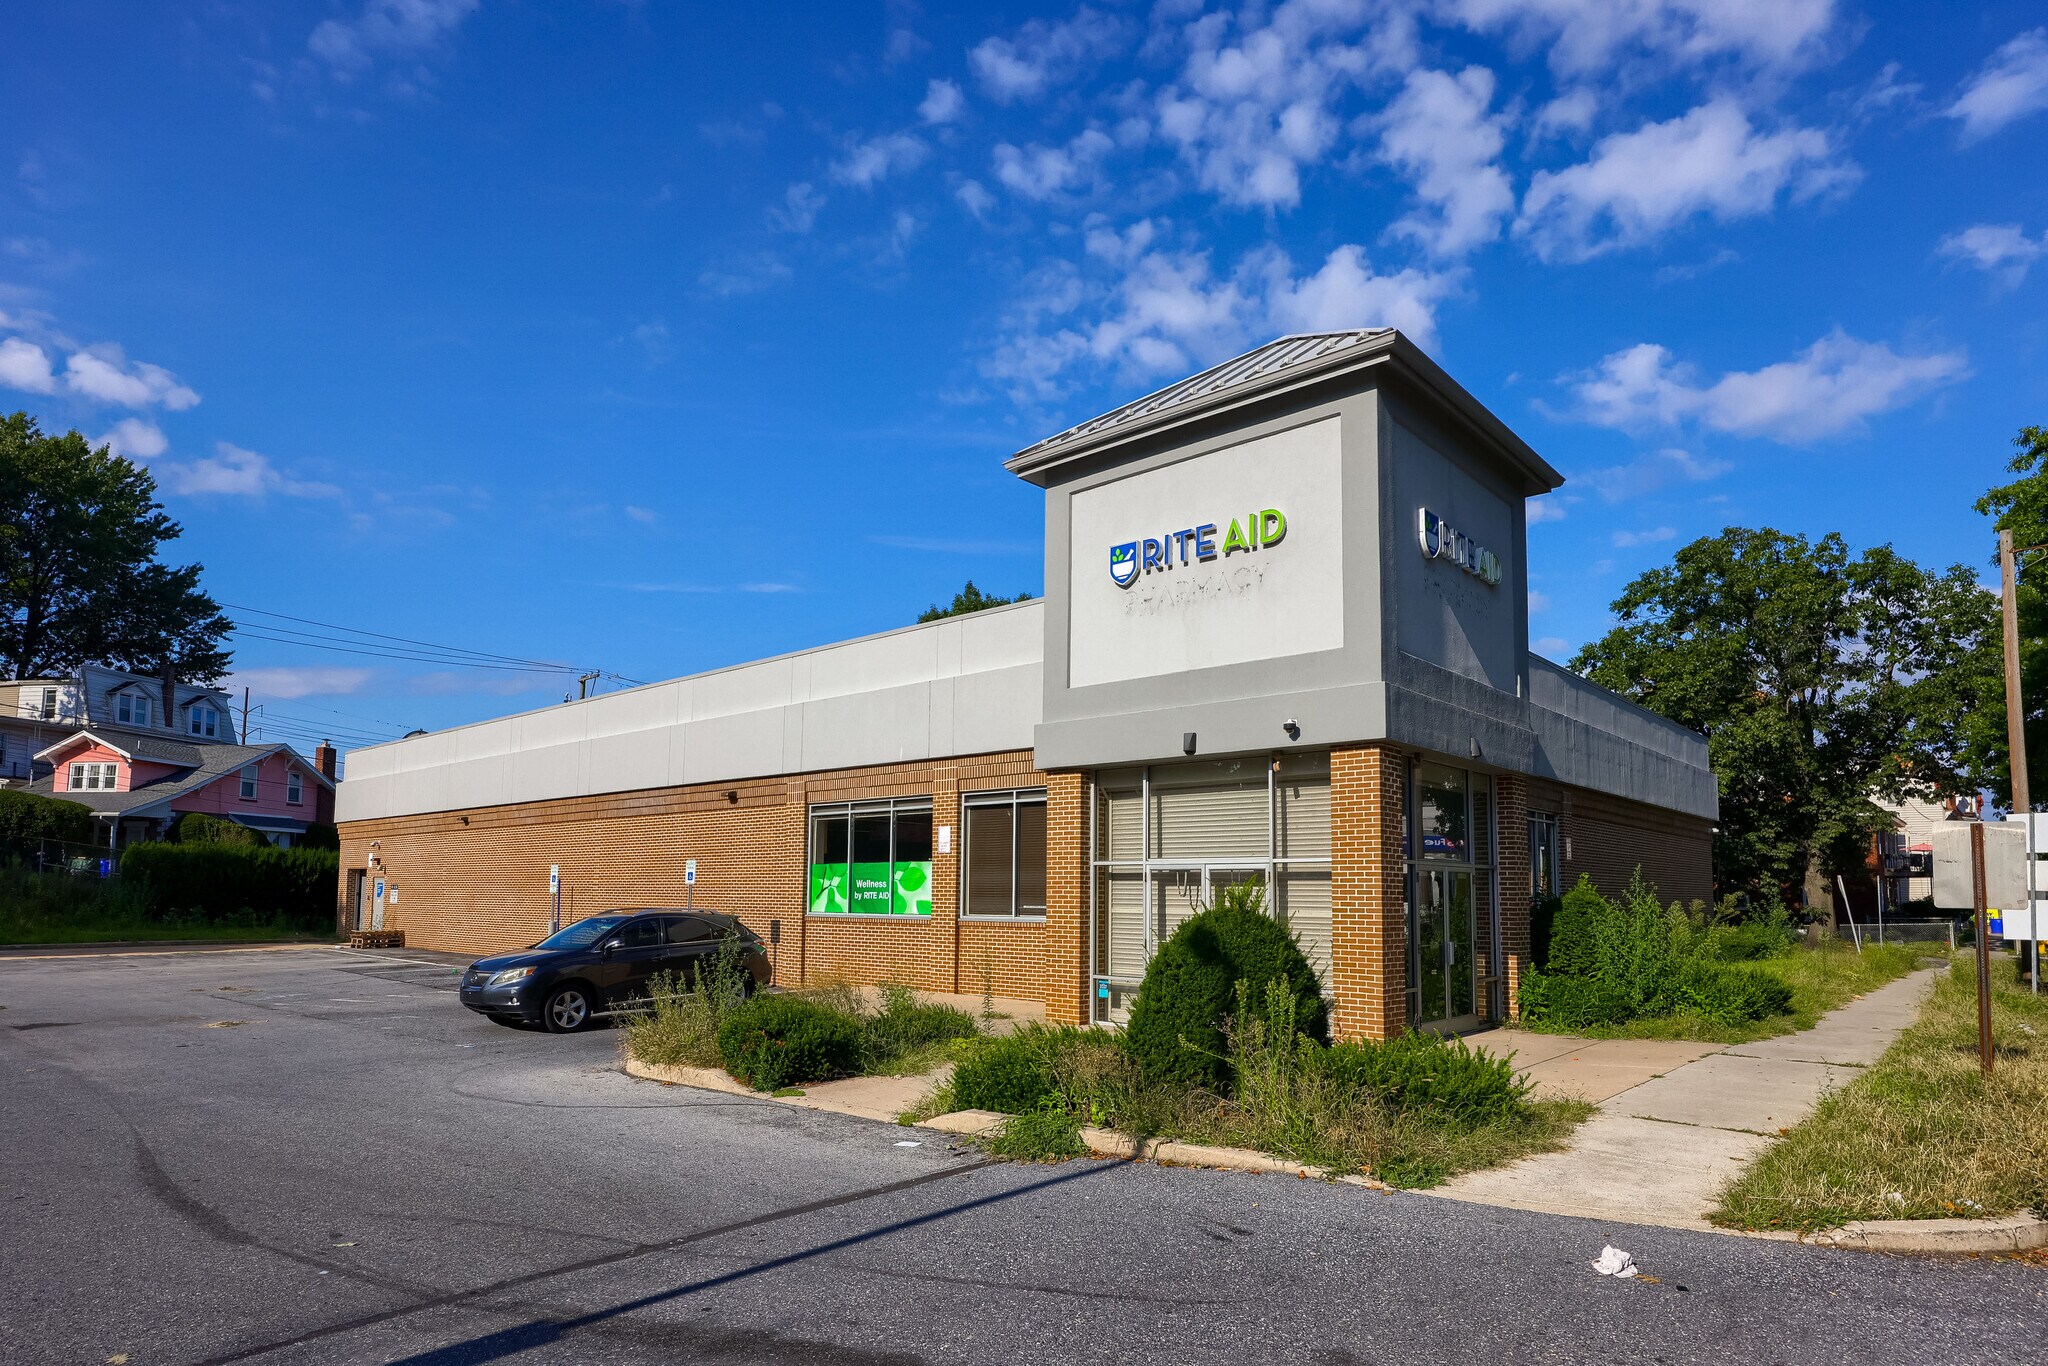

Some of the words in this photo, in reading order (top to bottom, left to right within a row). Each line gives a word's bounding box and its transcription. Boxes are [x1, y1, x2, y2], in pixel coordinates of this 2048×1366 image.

[1142, 523, 1217, 573] RITE
[1222, 508, 1287, 556] AID
[1440, 521, 1476, 572] RITE
[1475, 547, 1502, 585] AID
[854, 891, 862, 900] by
[863, 891, 878, 899] RITE
[856, 880, 887, 888] Wellness
